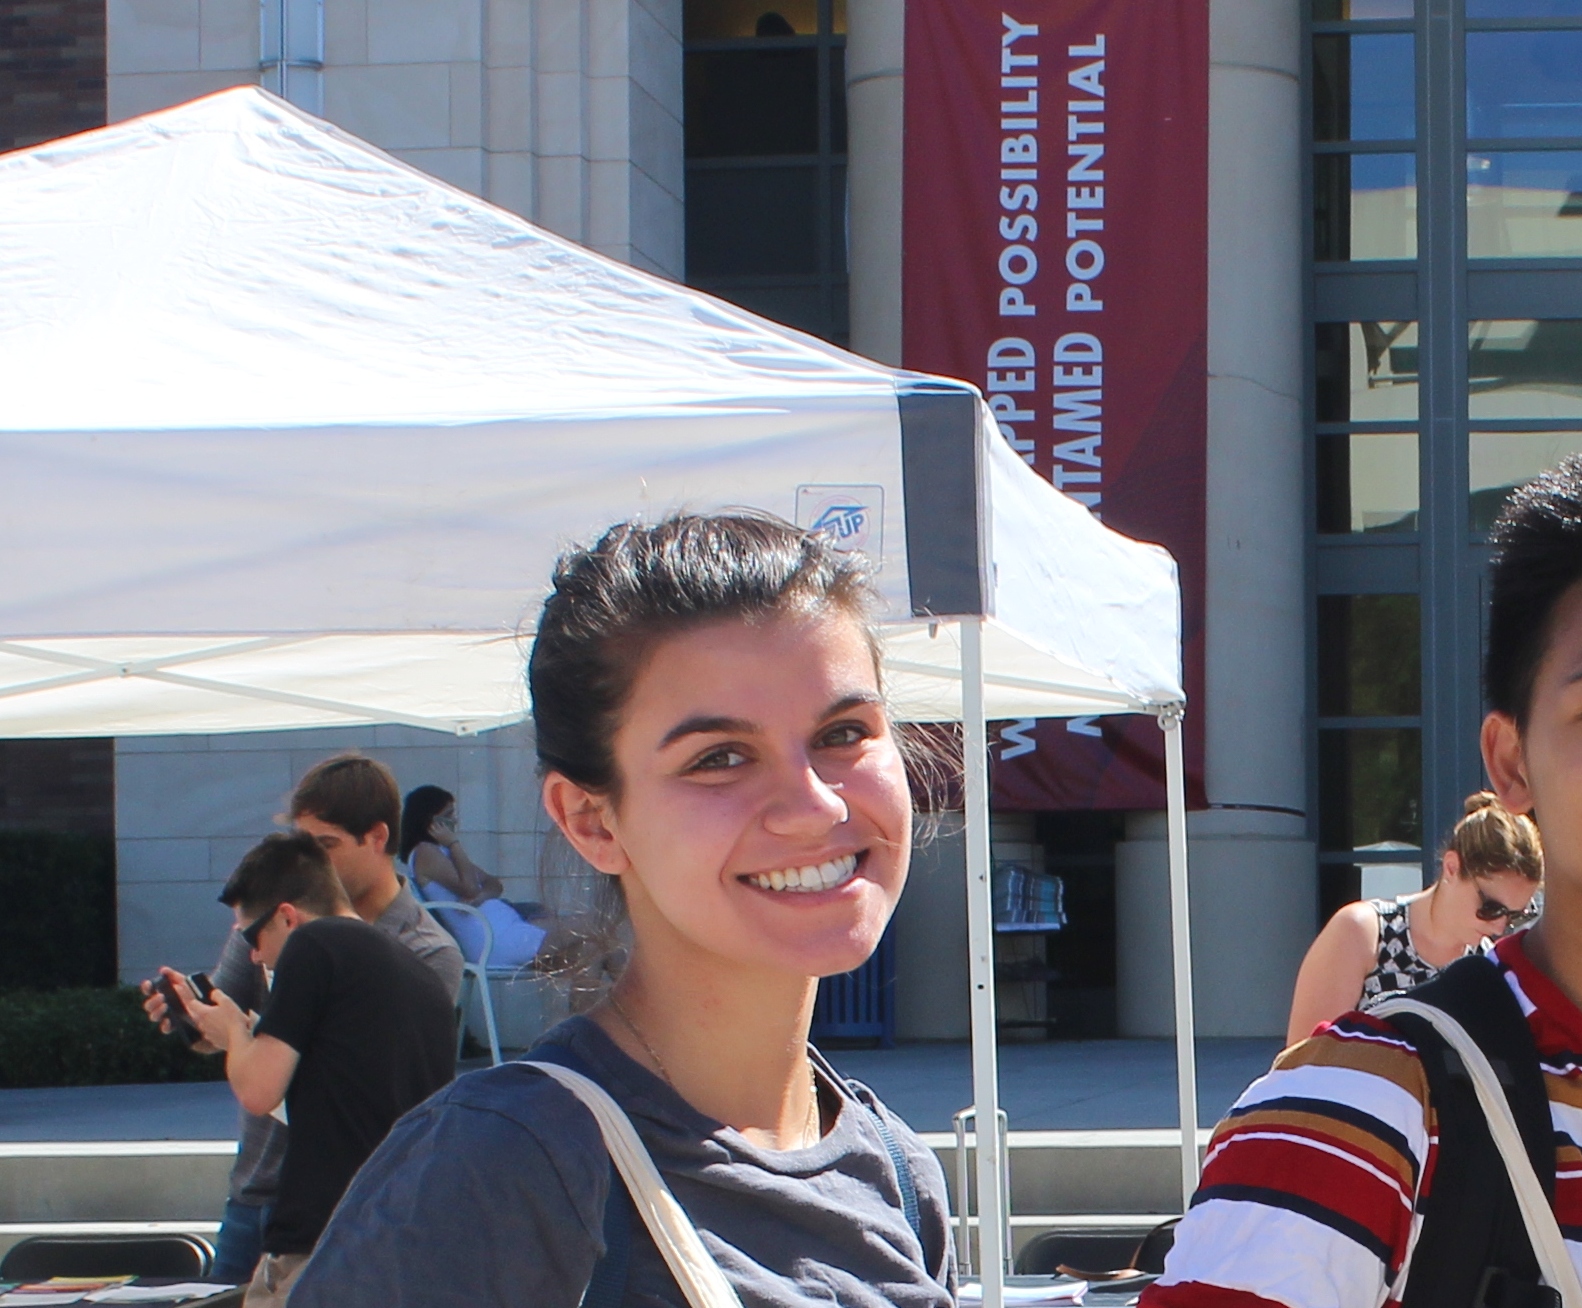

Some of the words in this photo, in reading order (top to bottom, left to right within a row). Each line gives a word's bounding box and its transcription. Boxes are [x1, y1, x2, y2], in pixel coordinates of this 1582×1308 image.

[999, 12, 1038, 315] POSSIBILITY
[1066, 34, 1105, 311] POTENTIAL
[987, 337, 1036, 464] PPED
[1052, 332, 1103, 520] TAMED
